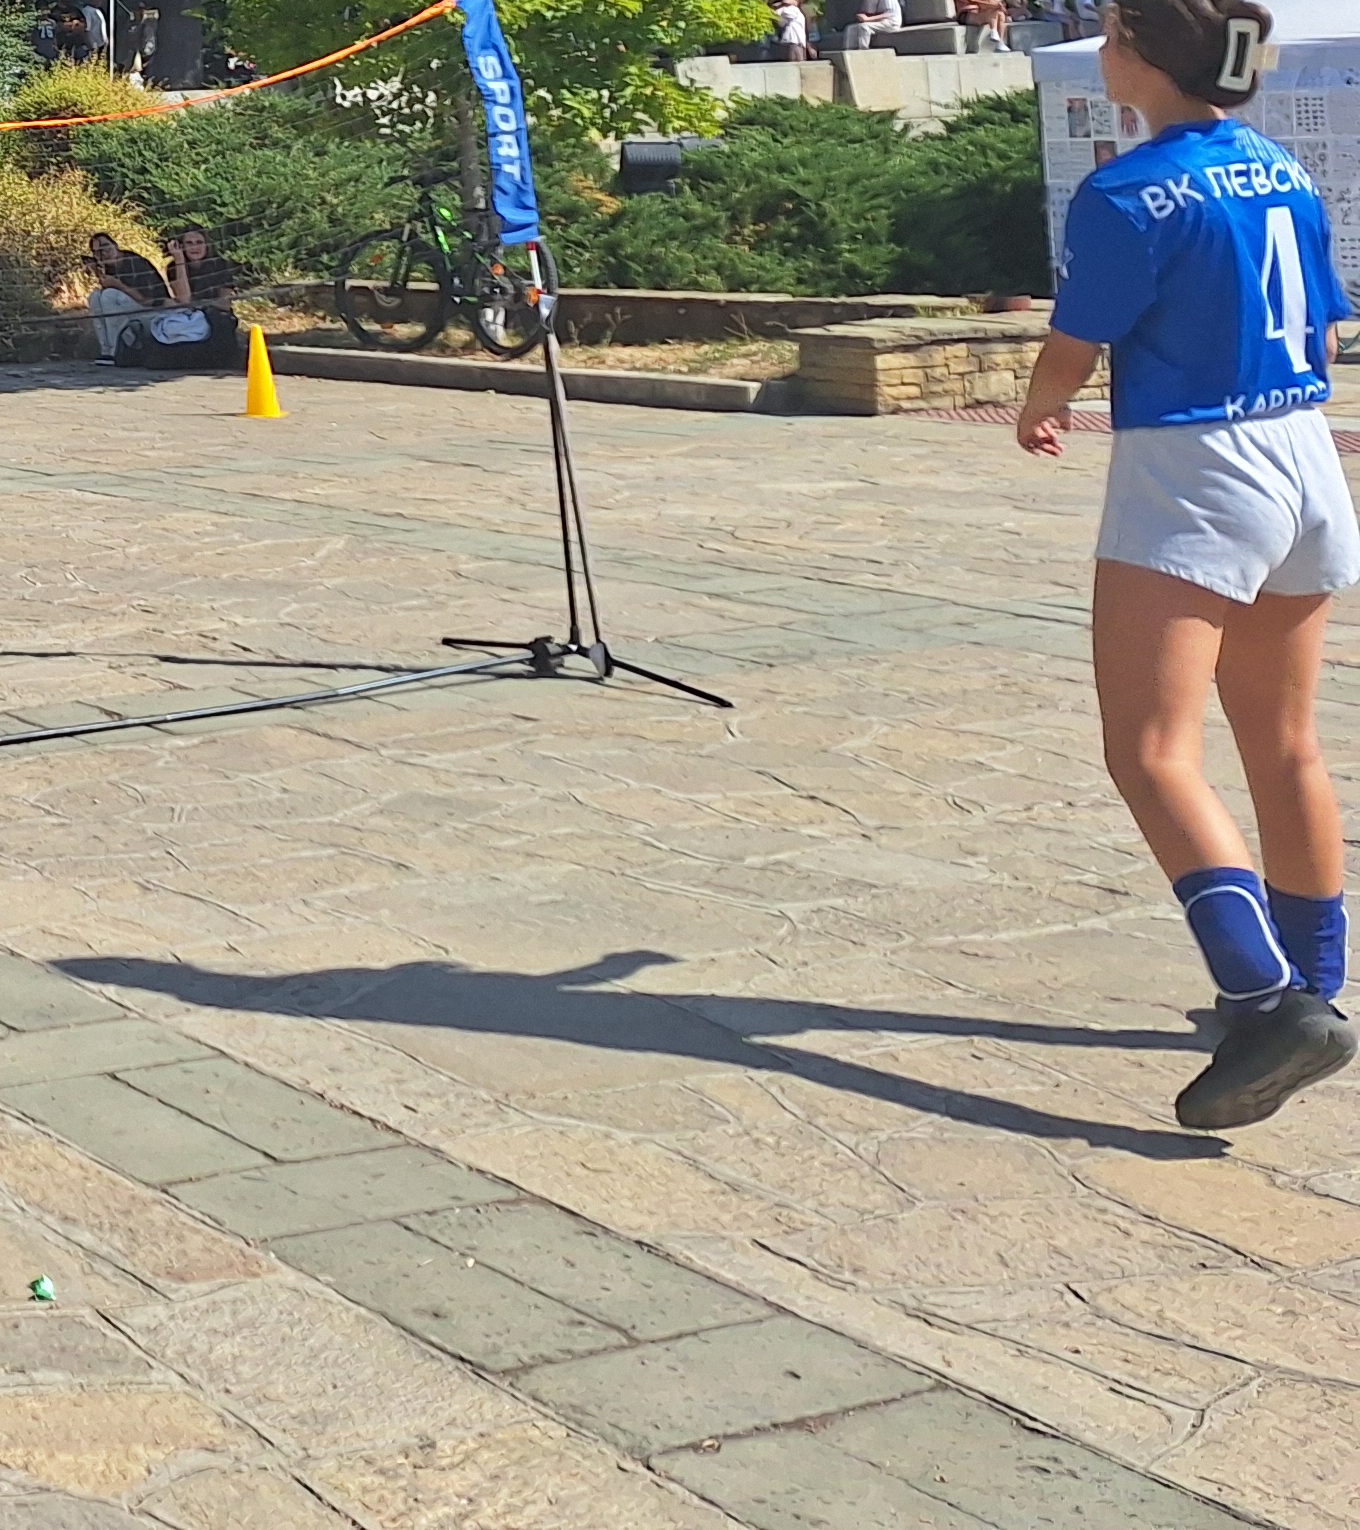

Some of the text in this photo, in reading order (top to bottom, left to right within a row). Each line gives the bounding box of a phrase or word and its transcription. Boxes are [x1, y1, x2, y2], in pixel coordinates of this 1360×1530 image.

[478, 55, 521, 181] SPORT
[1139, 172, 1205, 220] ВК
[1260, 206, 1313, 374] 4
